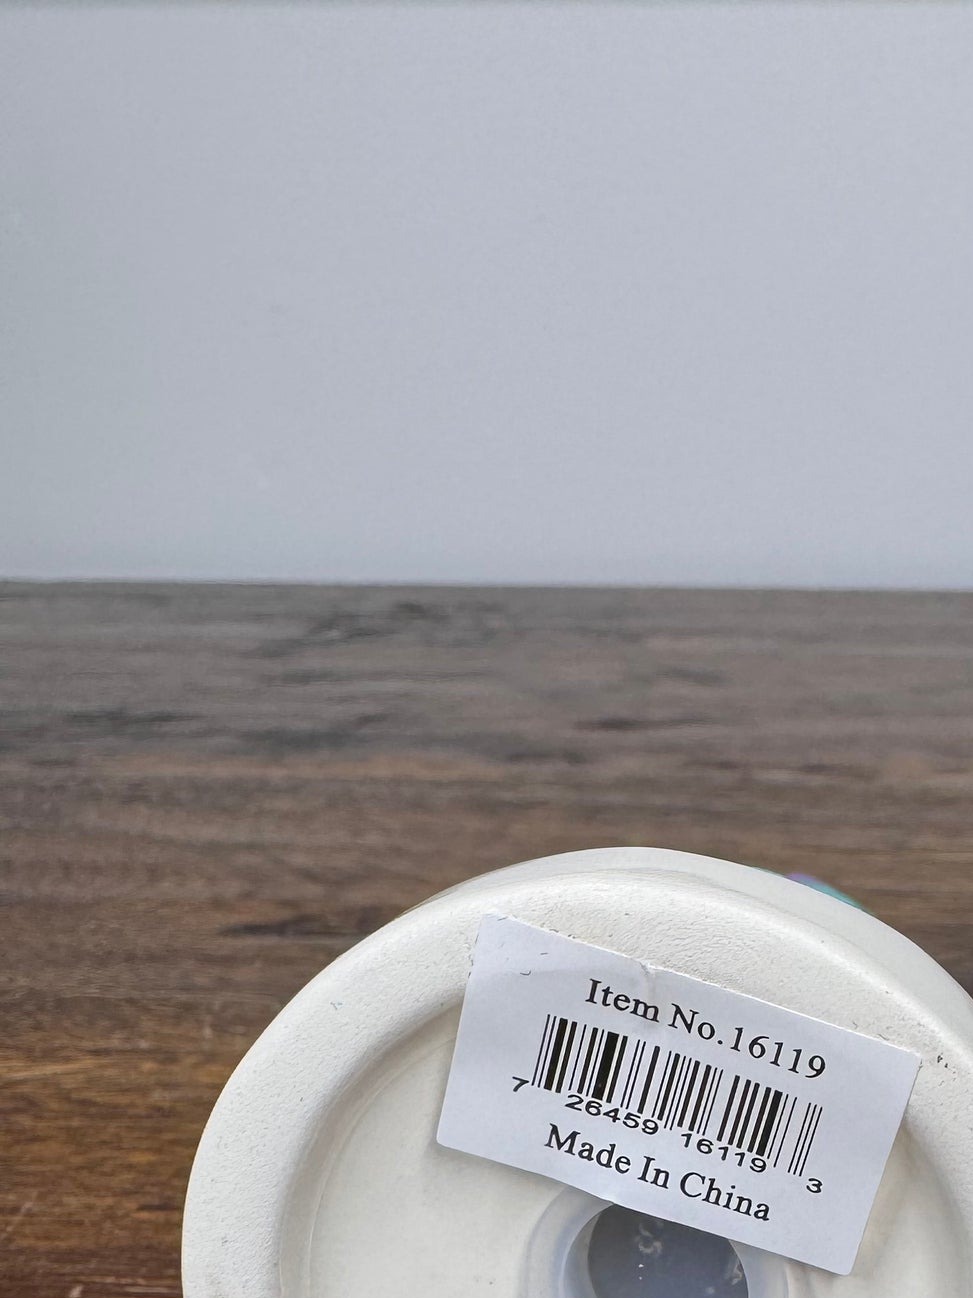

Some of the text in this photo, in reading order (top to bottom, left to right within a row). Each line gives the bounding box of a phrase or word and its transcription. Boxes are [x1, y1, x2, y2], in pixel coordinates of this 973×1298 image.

[584, 978, 827, 1080] Item No.16119
[511, 1076, 823, 1194] 7 26459 16119 3
[543, 1123, 771, 1222] Made In China
